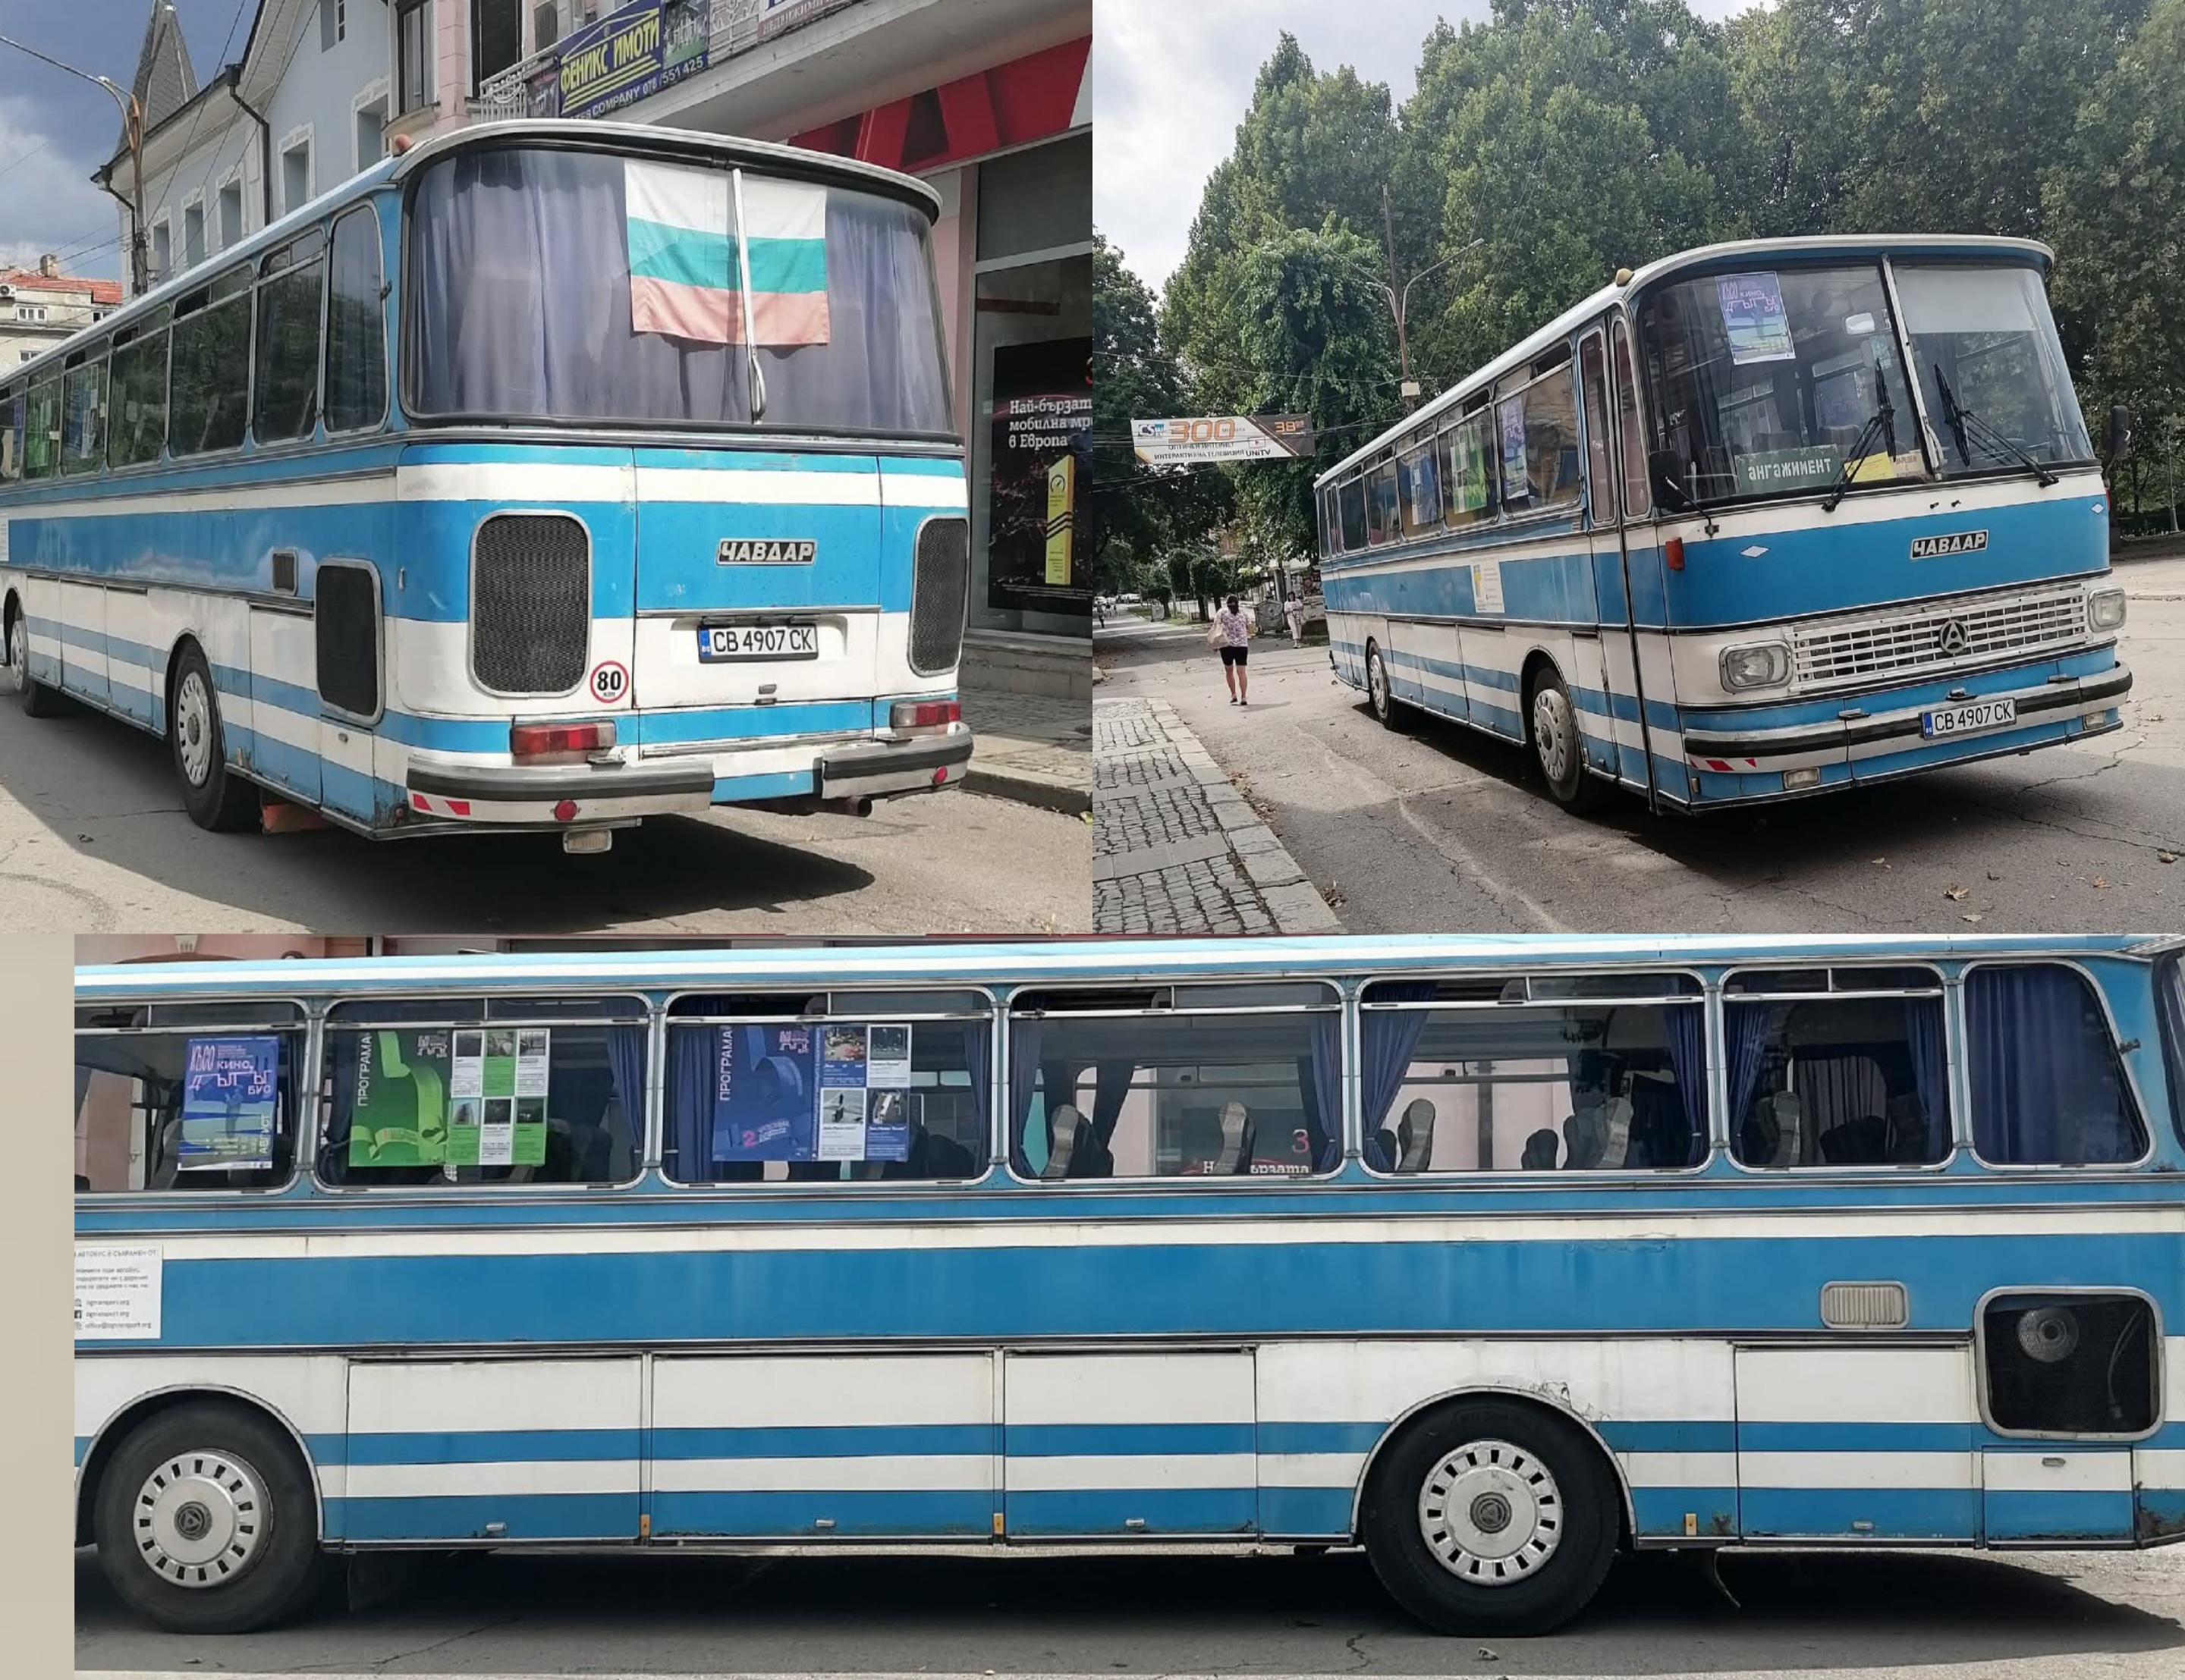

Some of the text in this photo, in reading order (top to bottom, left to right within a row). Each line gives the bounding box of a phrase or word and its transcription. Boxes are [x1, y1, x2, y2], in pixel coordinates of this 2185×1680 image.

[561, 17, 660, 94] ФЕНИКС ИМОТИ
[592, 86, 641, 117] COMPANY
[683, 55, 704, 76] 425
[1009, 416, 1067, 432] мобилна
[1168, 419, 1236, 443] 300
[1008, 433, 1069, 451] в Европа
[720, 542, 814, 561] ЧАВДАР
[1913, 532, 1985, 556] ЧАВДАР
[742, 630, 786, 652] 4907
[597, 670, 622, 691] 80
[1957, 706, 1992, 727] 4907
[358, 1035, 372, 1107] ПРОГРАМА
[719, 1029, 733, 1101] ПРОГРАМА
